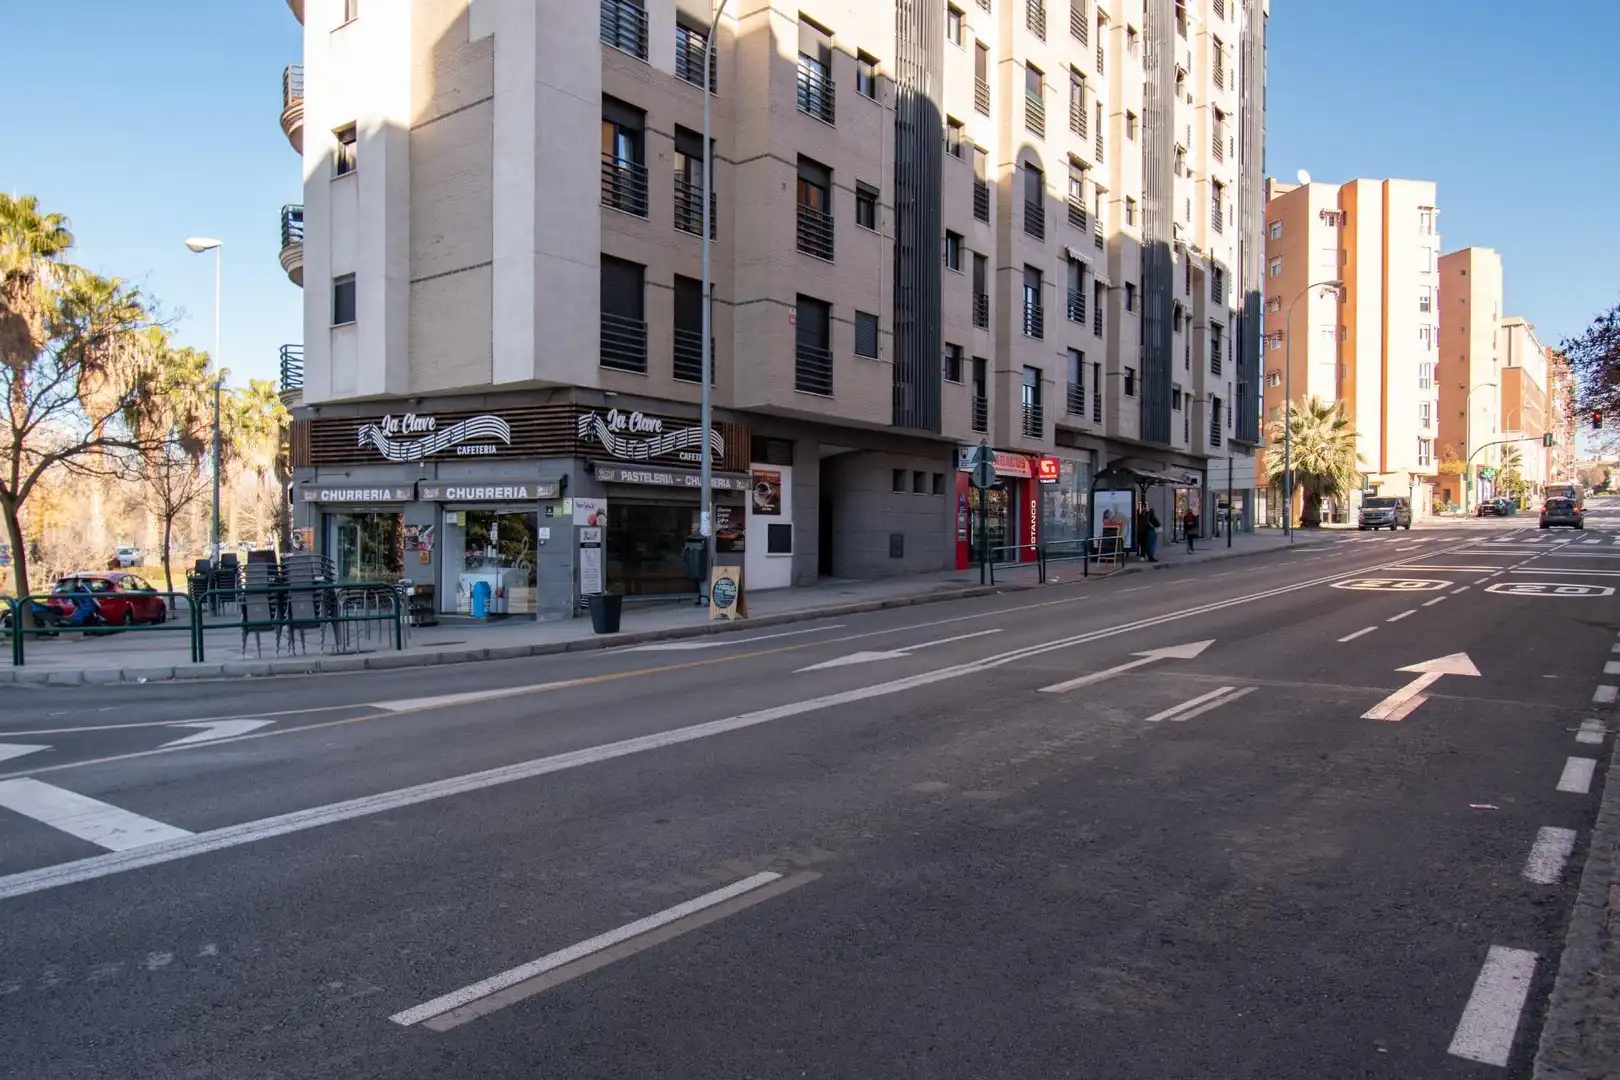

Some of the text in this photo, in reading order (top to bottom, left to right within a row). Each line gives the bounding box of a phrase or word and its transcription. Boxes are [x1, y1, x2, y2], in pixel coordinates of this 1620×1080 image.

[382, 413, 436, 437] La Clave
[607, 408, 663, 433] La Clave
[456, 444, 497, 455] CAFETERIA
[621, 470, 673, 485] PASTELERIA
[321, 489, 391, 500] CHURRERIA
[446, 486, 528, 499] CHURRERIA
